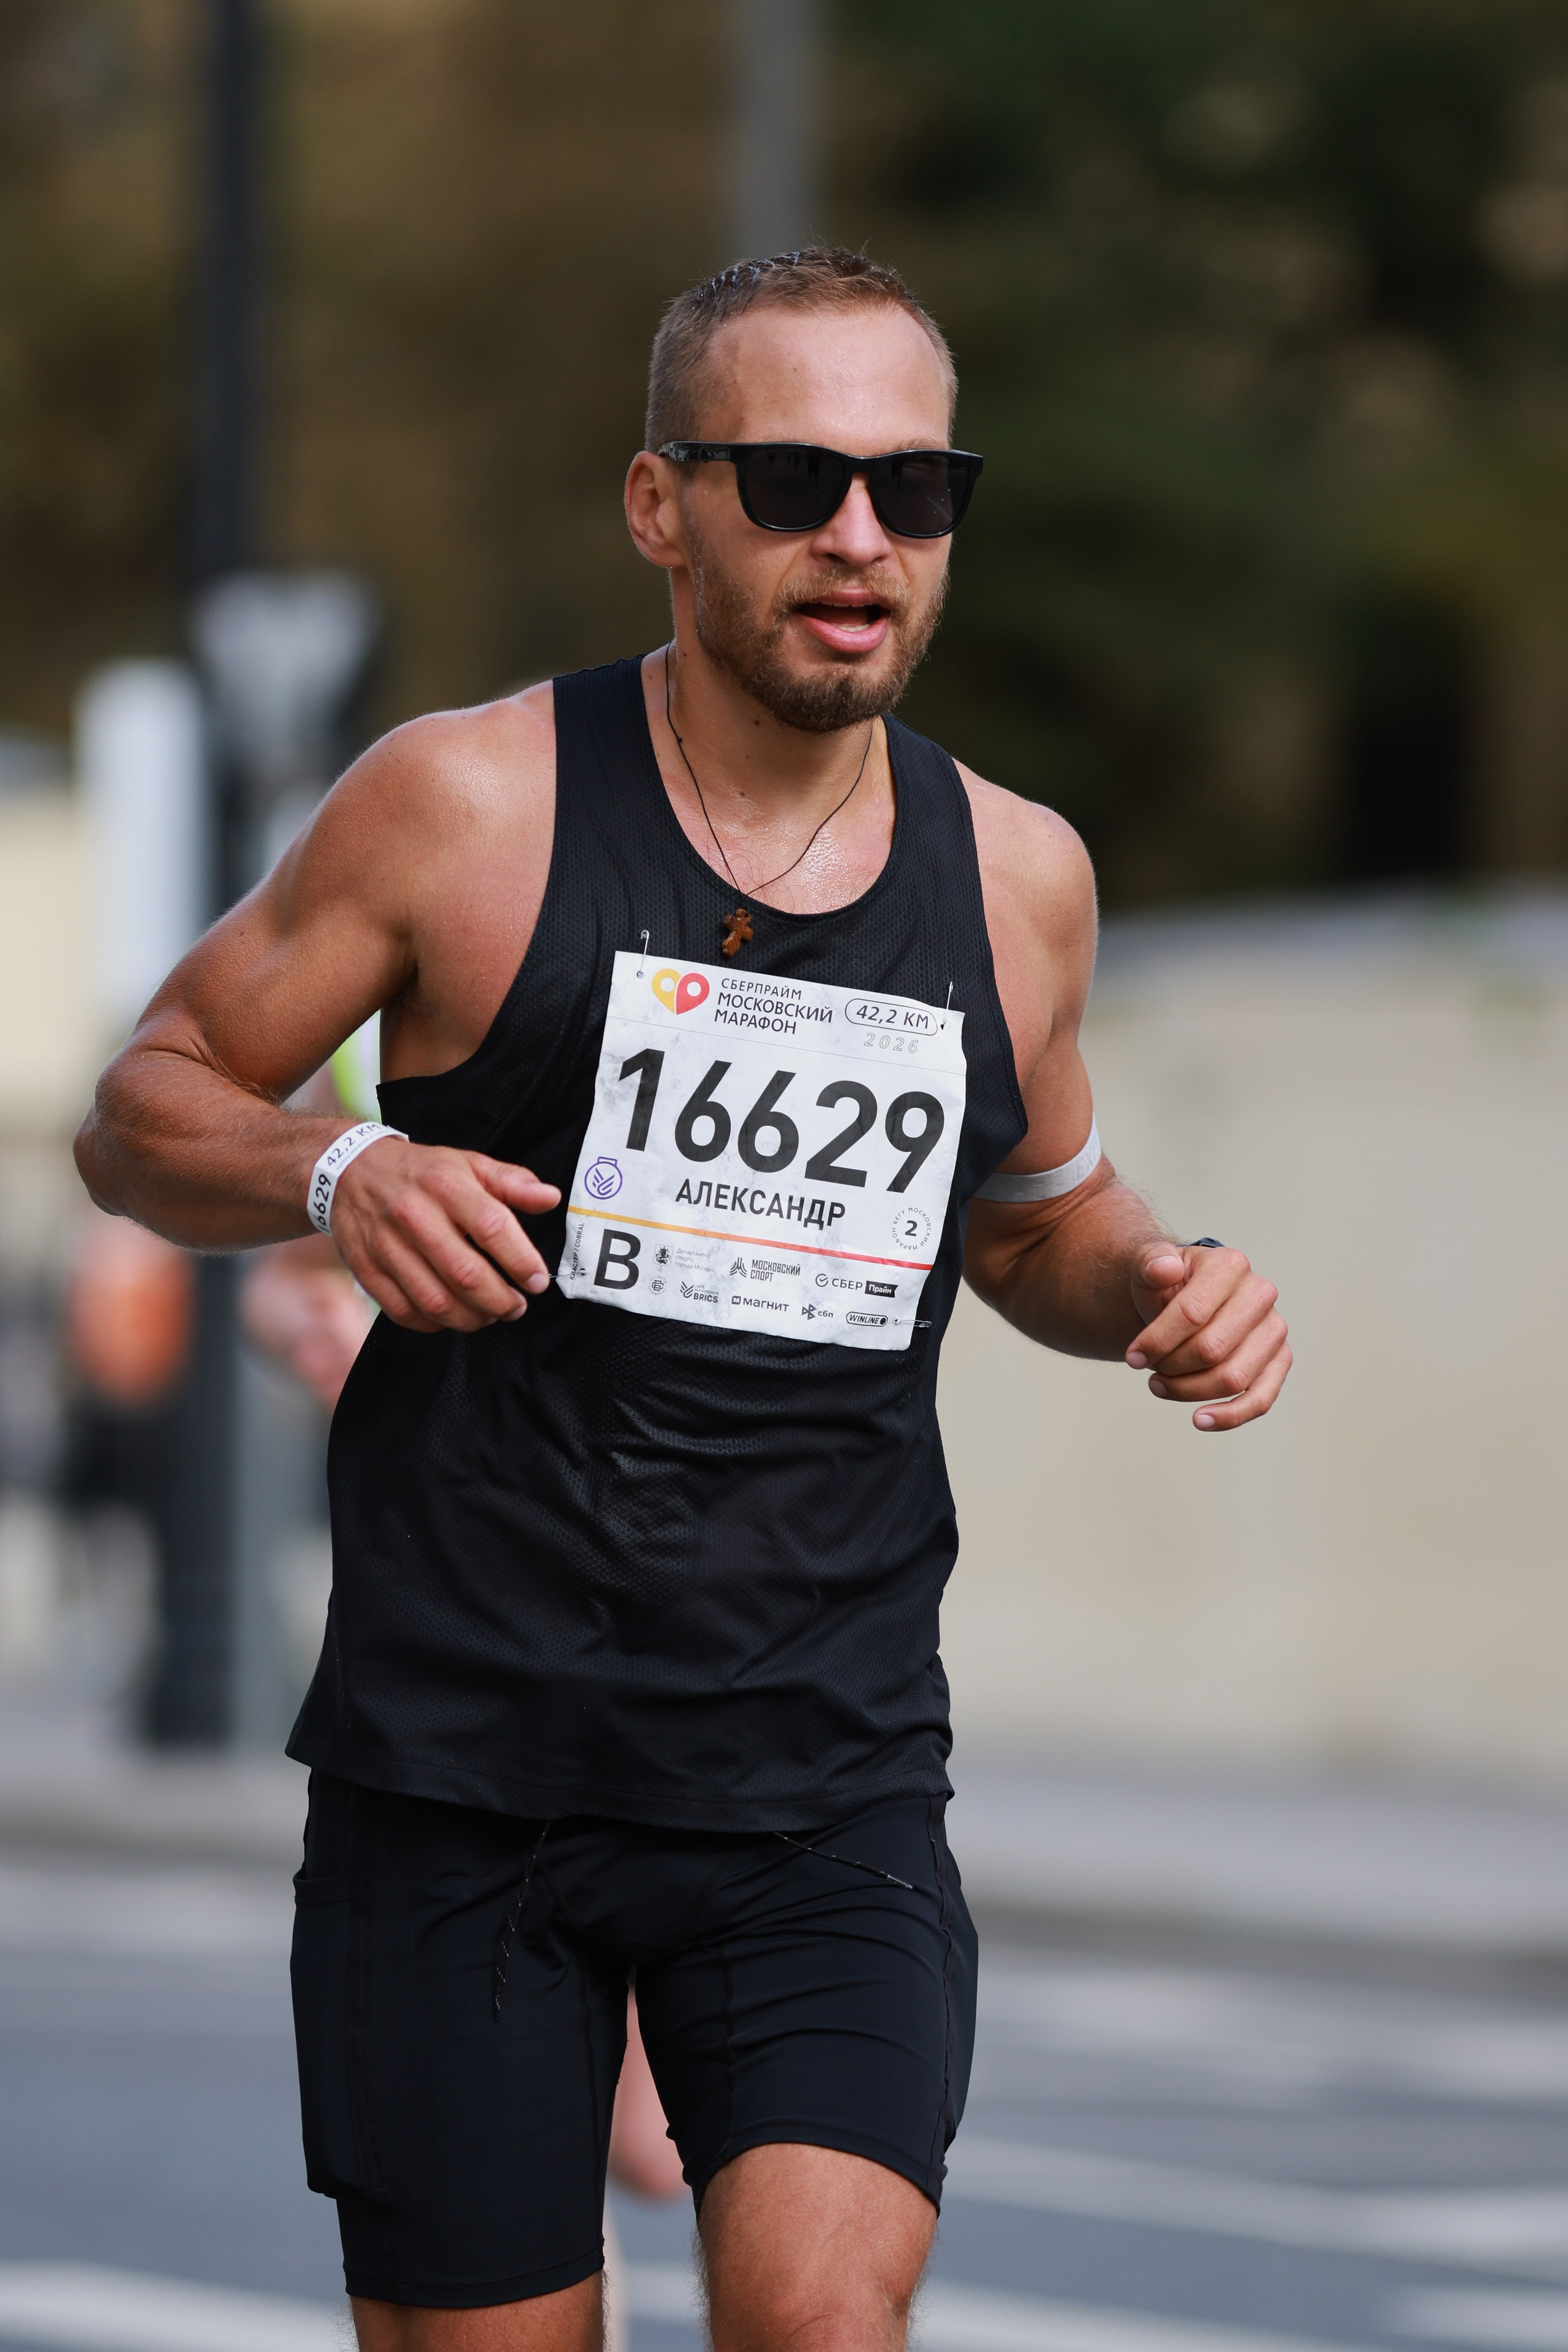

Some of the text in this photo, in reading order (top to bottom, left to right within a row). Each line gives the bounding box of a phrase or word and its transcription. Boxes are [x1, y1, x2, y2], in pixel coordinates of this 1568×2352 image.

[721, 978, 802, 1000] СБЕРПРАЙМ
[717, 992, 832, 1023] МОСКОВСКИЙ
[856, 1004, 929, 1029] 42,2 КМ
[714, 1009, 797, 1035] МАРАФОН
[864, 1033, 919, 1054] 2026
[618, 1048, 944, 1193] 16629
[326, 1137, 356, 1166] 42,2
[676, 1178, 845, 1231] АЛЕКСАНДР
[905, 1220, 918, 1237] 2
[676, 1248, 710, 1258] Департамент
[750, 1270, 774, 1282] СПОРТ
[752, 1259, 801, 1276] МОСКОВСКИЙ
[832, 1278, 892, 1294] СБЕР Прайм
[693, 1293, 718, 1303] BRICS
[849, 1314, 880, 1324] WINLINE
